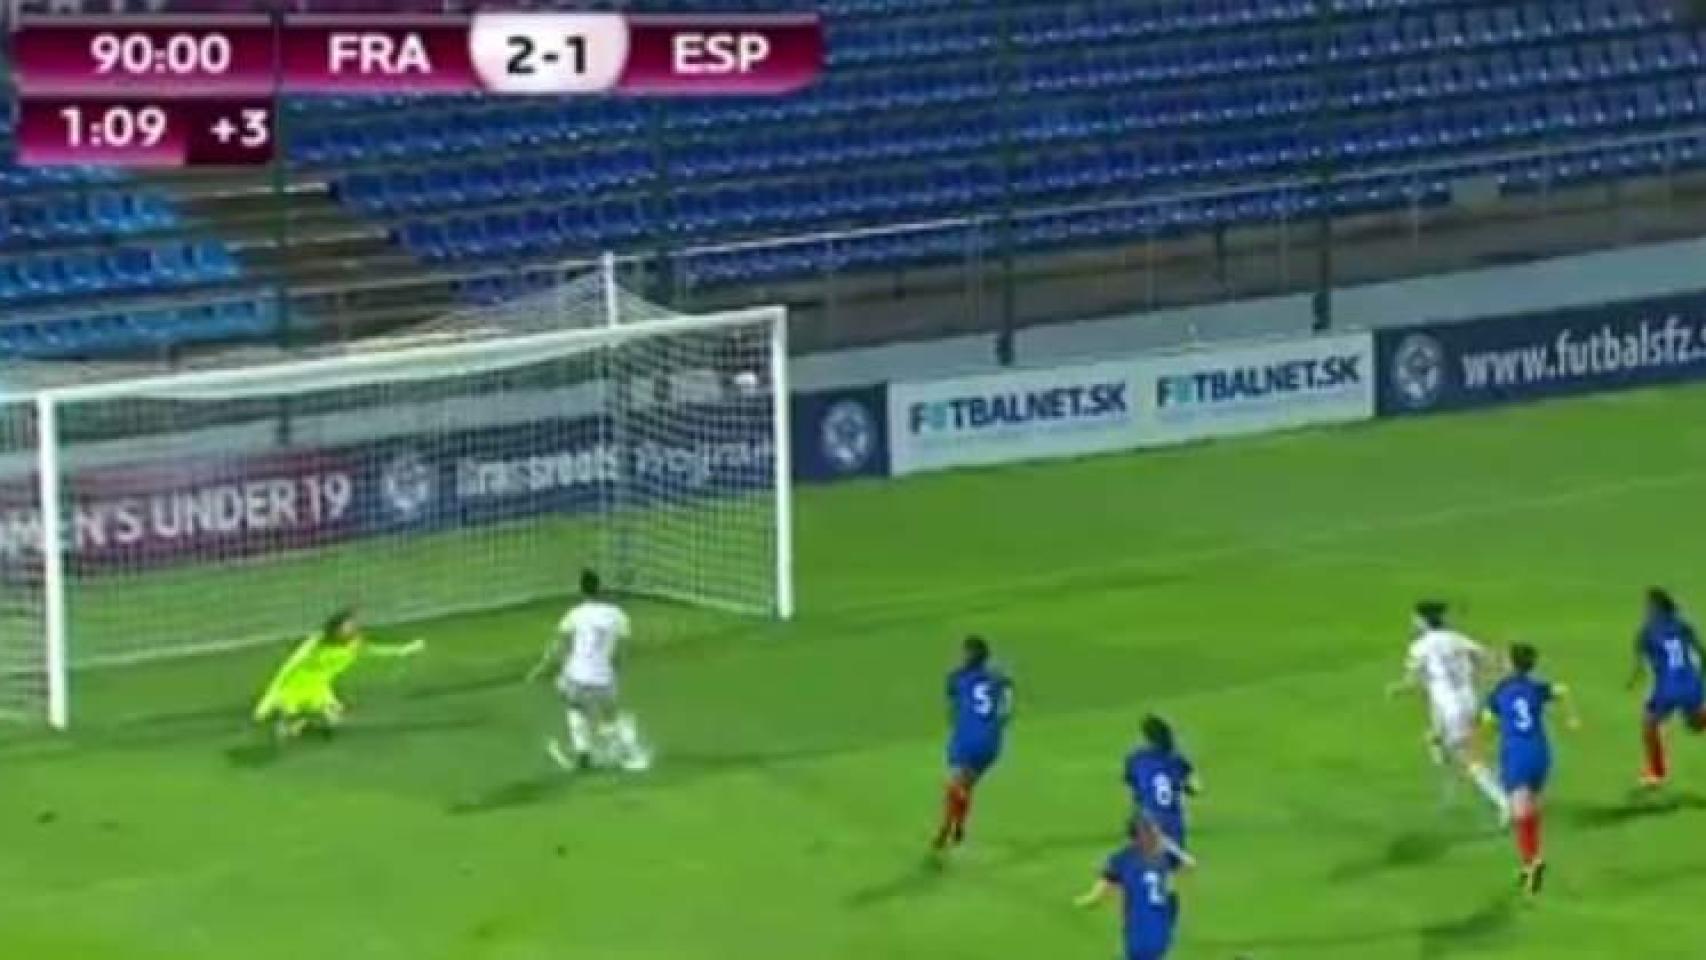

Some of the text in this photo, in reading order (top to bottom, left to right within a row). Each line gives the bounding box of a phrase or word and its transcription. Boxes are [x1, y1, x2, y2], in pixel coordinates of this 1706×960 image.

[152, 478, 298, 537] UNDER
[302, 472, 350, 527] 19
[973, 683, 993, 715] 5
[1513, 697, 1534, 732] 3
